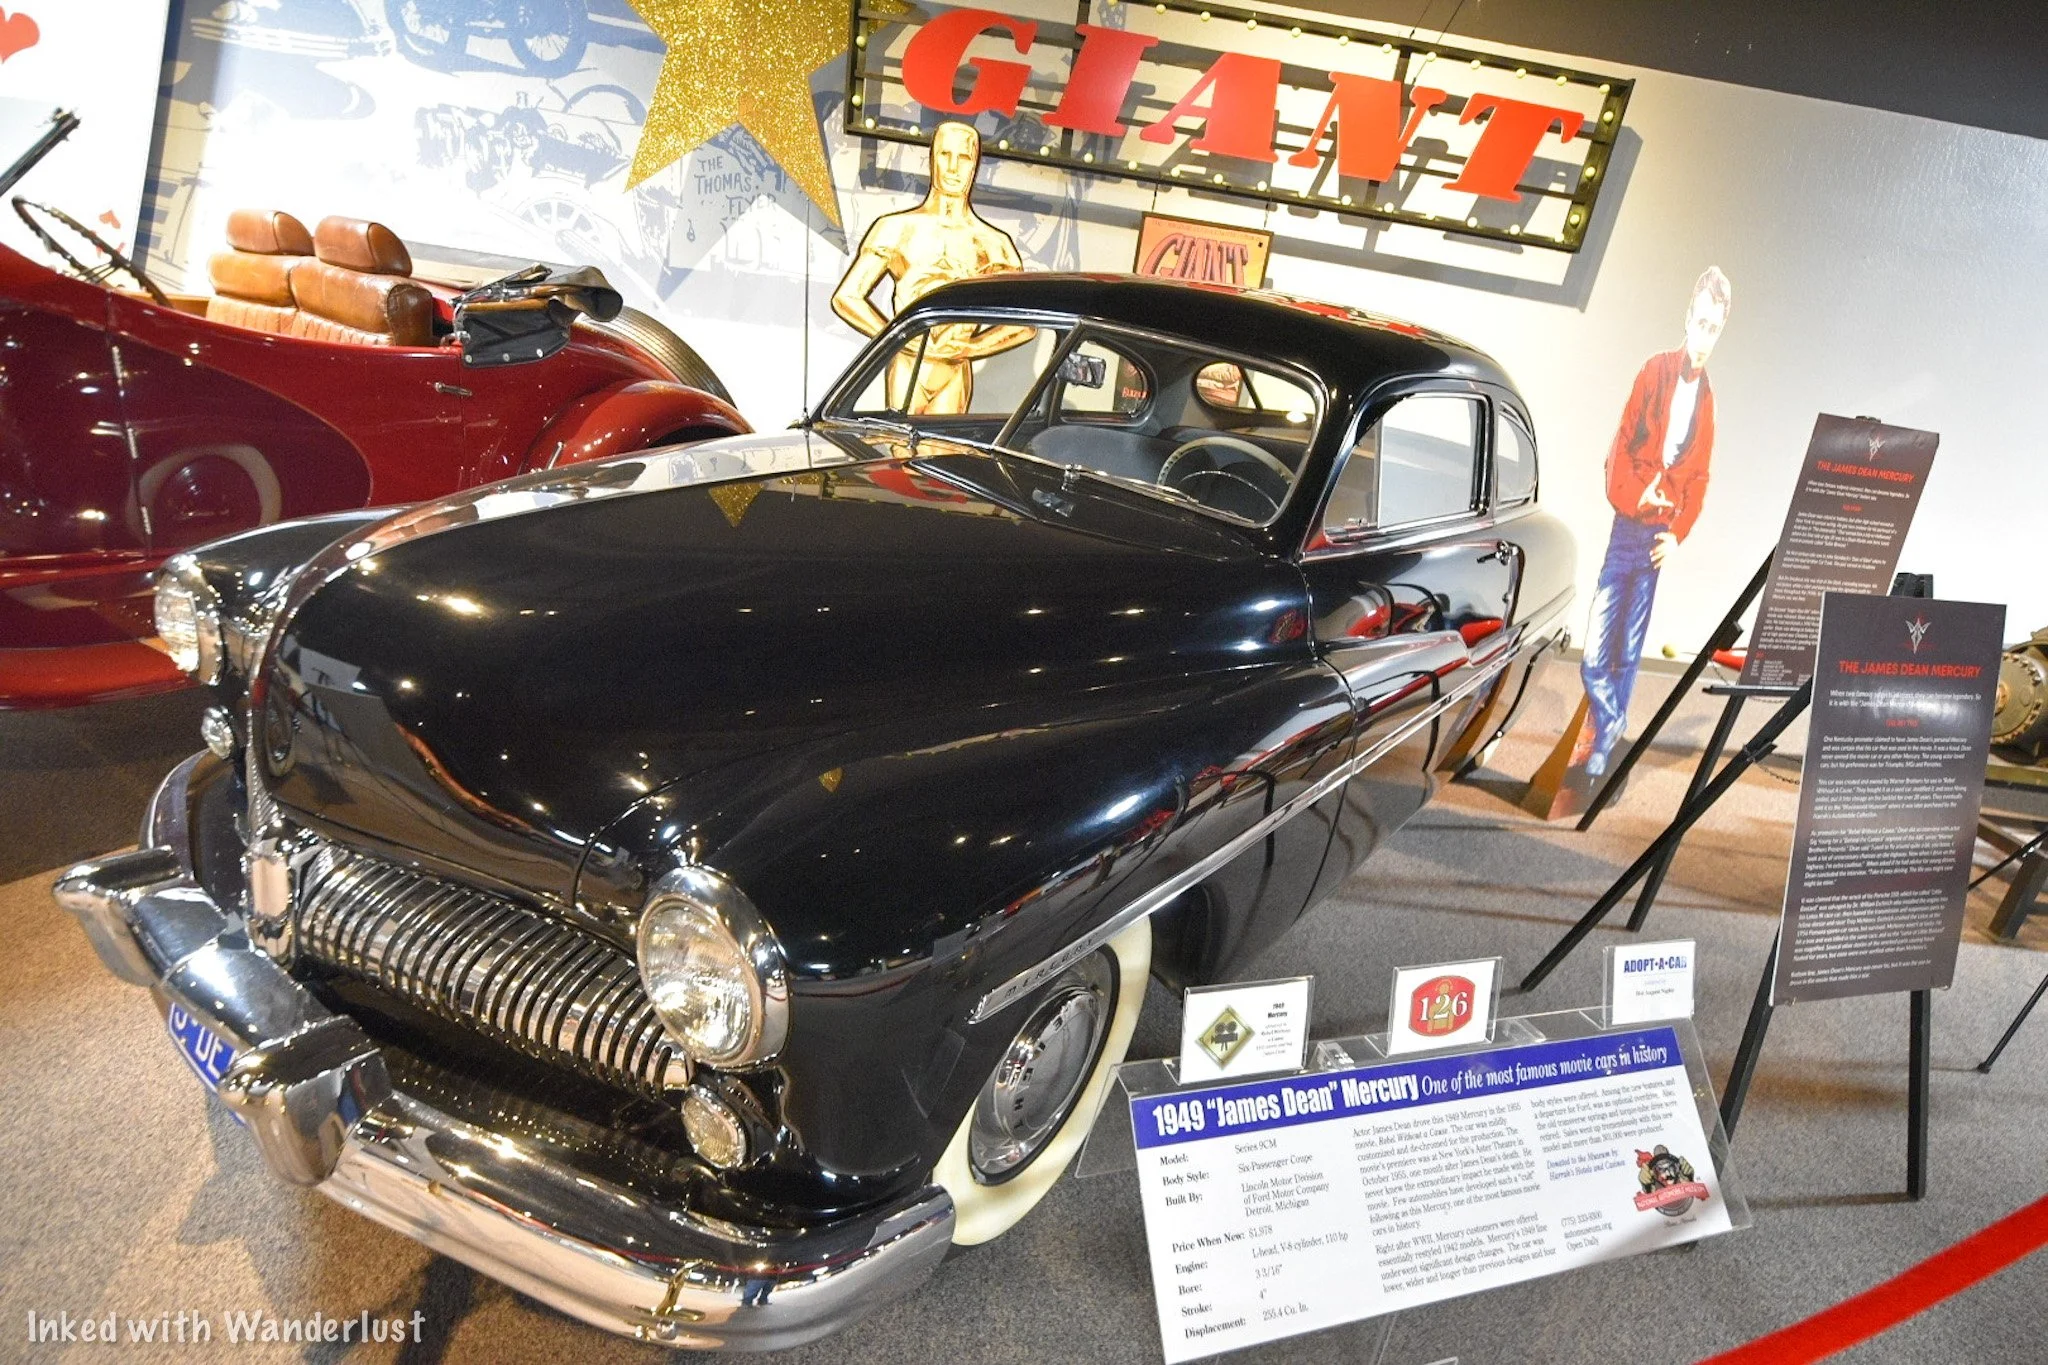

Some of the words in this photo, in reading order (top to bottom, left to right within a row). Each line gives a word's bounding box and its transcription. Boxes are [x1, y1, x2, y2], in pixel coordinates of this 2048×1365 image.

[901, 8, 1585, 203] GIANT
[697, 156, 723, 172] THE
[1817, 460, 1831, 471] THE
[1832, 463, 1857, 475] JAMES
[1858, 466, 1880, 478] DEAN
[1880, 469, 1915, 483] MERCURY
[1839, 660, 1859, 674] THE
[1861, 662, 1898, 675] JAMES
[1900, 663, 1928, 676] DEAN
[1930, 665, 1981, 678] MERCURY
[1420, 992, 1468, 1021] 126
[1153, 1100, 1204, 1135] 1949
[1341, 1075, 1418, 1106] Mercury
[1421, 1075, 1447, 1095] One
[1450, 1071, 1462, 1093] of
[1464, 1069, 1482, 1088] the
[1486, 1066, 1513, 1085] most
[1516, 1062, 1556, 1084] famous
[1559, 1053, 1591, 1073] movie
[1595, 1054, 1617, 1069] cars
[1618, 1048, 1630, 1065] in
[1632, 1044, 1666, 1063] history
[1234, 1144, 1257, 1153] Series
[1258, 1138, 1276, 1149] 9CM
[1160, 1153, 1188, 1164] Model:
[1290, 1154, 1312, 1164] Coupe
[1162, 1174, 1183, 1185] Body
[1186, 1171, 1208, 1181] Style:
[1241, 1180, 1268, 1192] Lincoln
[1269, 1177, 1292, 1187] Motor
[1293, 1171, 1323, 1183] Division
[1165, 1194, 1186, 1206] Built
[1188, 1192, 1202, 1202] By:
[1243, 1194, 1250, 1204] of
[1252, 1191, 1270, 1203] Ford
[1271, 1189, 1293, 1199] Motor
[1295, 1183, 1328, 1194] Company
[1245, 1203, 1273, 1216] Detroit,
[1275, 1199, 1308, 1210] Michigan
[1172, 1242, 1194, 1252] Price
[1196, 1237, 1221, 1247] When
[1223, 1233, 1244, 1242] New:
[1293, 1237, 1323, 1249] cylinder,
[1325, 1232, 1337, 1243] 110
[1337, 1231, 1348, 1241] hp
[1175, 1262, 1207, 1273] Engine:
[1178, 1284, 1201, 1295] Bore:
[1181, 1304, 1211, 1316] Stroke:
[1283, 1305, 1297, 1315] Cu.
[1298, 1302, 1308, 1312] In.
[1185, 1318, 1245, 1338] Displacement:
